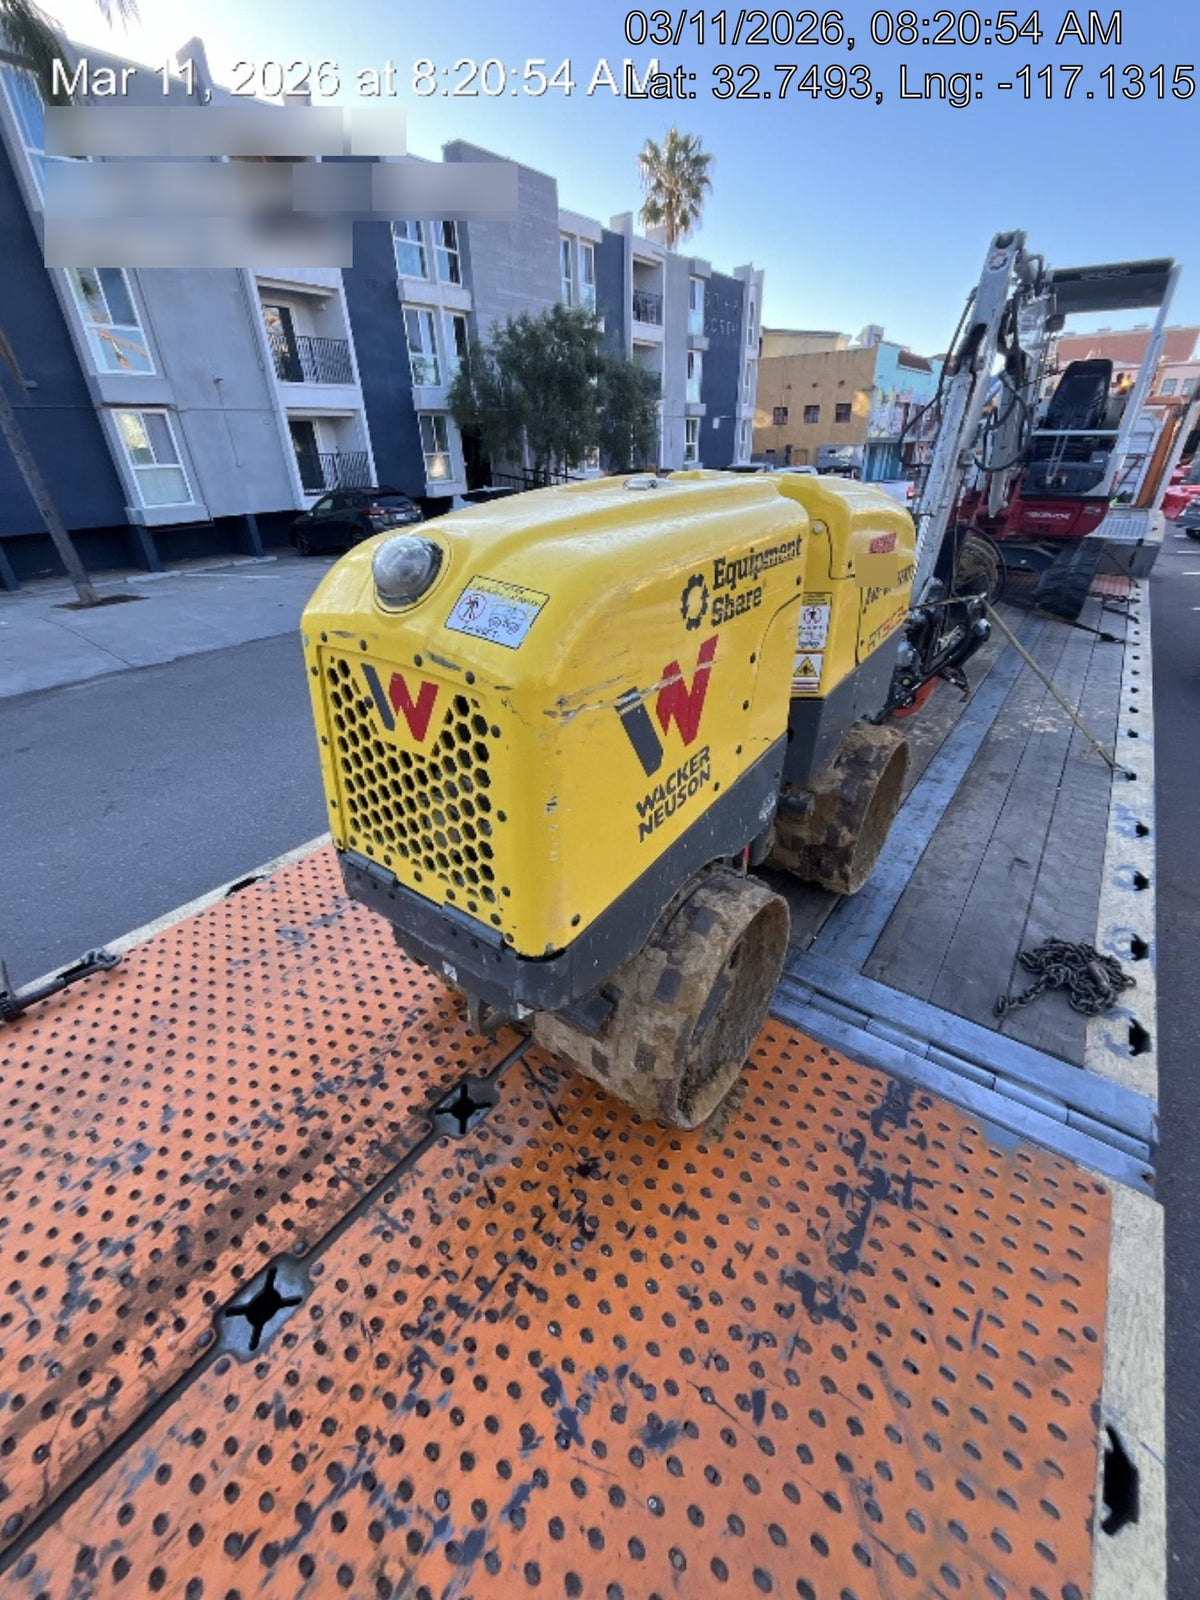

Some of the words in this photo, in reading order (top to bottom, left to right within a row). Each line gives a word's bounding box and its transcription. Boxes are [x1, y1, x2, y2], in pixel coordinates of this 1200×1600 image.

[713, 535, 802, 590] Equipment
[711, 586, 762, 627] Share
[636, 745, 710, 818] WACKER
[638, 763, 710, 843] NEUSON
